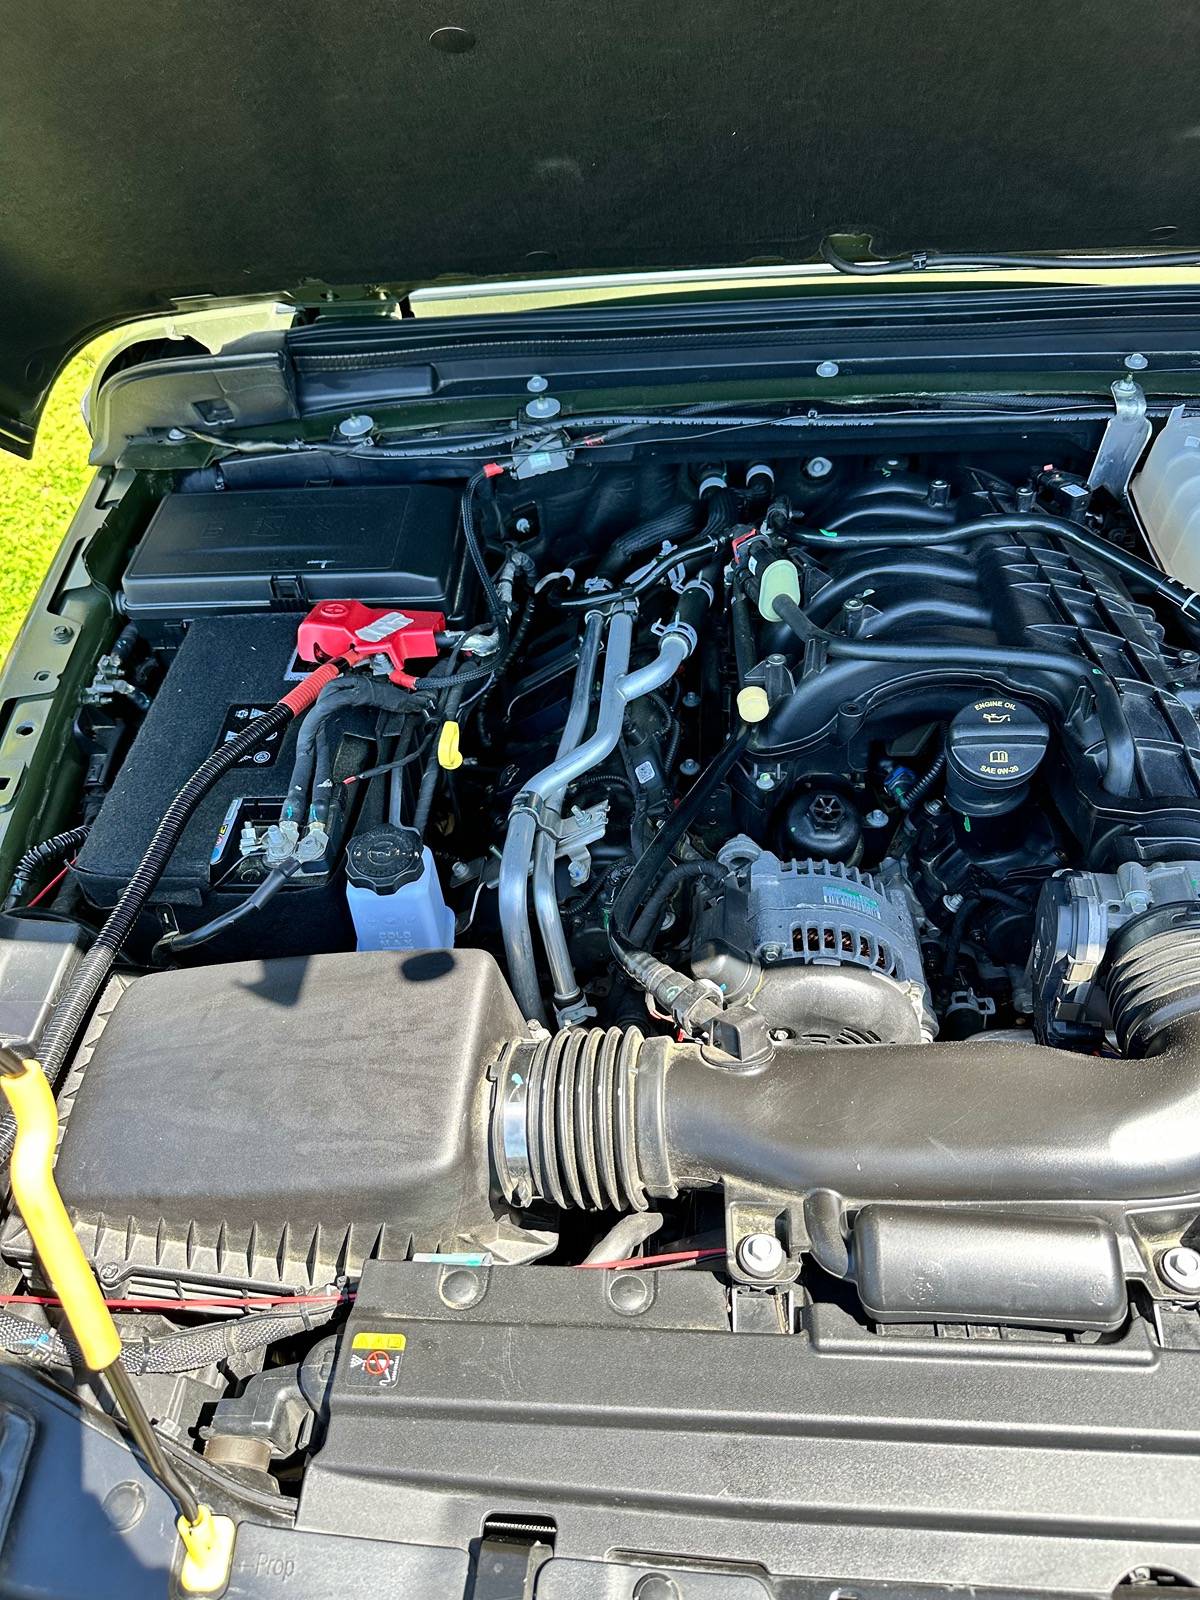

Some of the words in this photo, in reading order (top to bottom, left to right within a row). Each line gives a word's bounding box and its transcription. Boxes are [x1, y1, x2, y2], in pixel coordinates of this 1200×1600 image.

[974, 701, 1003, 711] ENGINE
[1004, 702, 1017, 711] OIL
[980, 765, 996, 775] SAE
[256, 1552, 295, 1582] Prop
